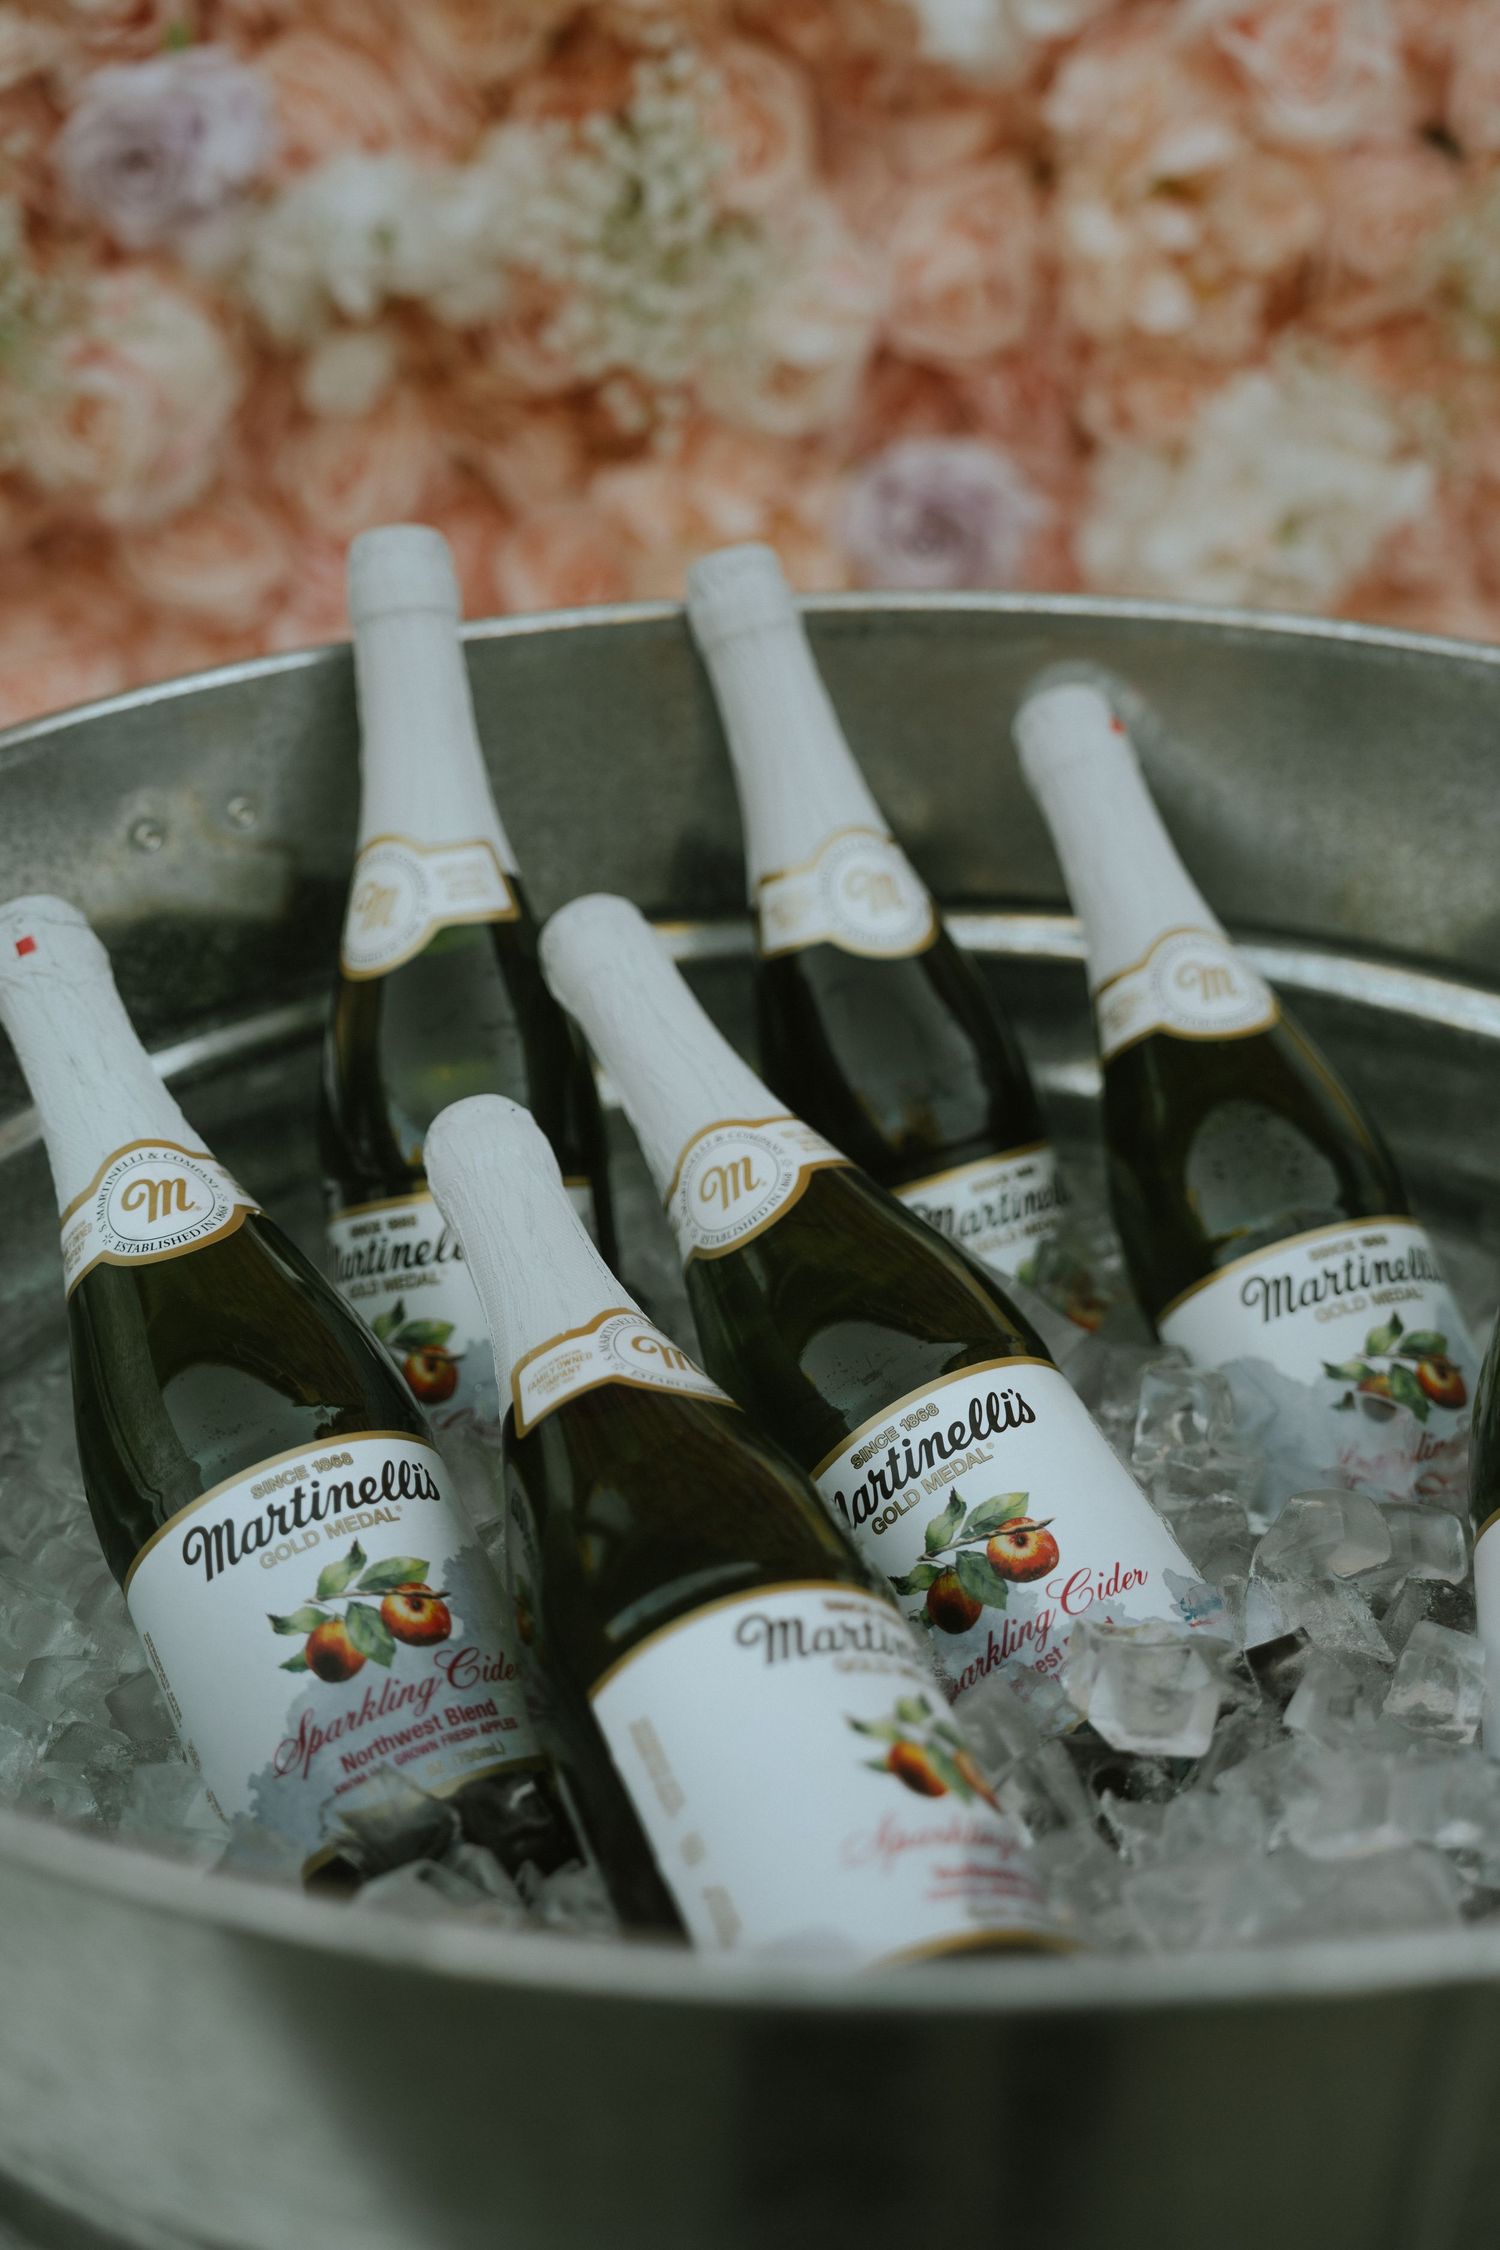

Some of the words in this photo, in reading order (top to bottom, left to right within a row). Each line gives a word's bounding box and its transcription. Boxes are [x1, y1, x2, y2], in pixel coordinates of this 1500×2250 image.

[97, 1152, 144, 1220] MARTINELLI
[147, 1151, 160, 1160] &
[163, 1151, 219, 1190] COMPANY
[121, 1178, 196, 1224] M
[700, 1156, 760, 1211] M
[114, 1229, 201, 1254] ESTABLISHED
[201, 1219, 216, 1233] IN
[213, 1204, 228, 1223] 1868
[850, 1426, 900, 1470] SINCE
[900, 1402, 940, 1431] 1868
[251, 1464, 309, 1500] SINCE
[311, 1451, 354, 1474] 1868
[182, 1460, 441, 1583] Martinelli's
[871, 1488, 922, 1536] GOLD
[259, 1530, 321, 1570] GOLD
[1045, 1561, 1149, 1616] Cider
[272, 1676, 443, 1780] Sparkling
[340, 1714, 443, 1775] Northwest
[444, 1698, 499, 1727] Blend
[393, 1741, 440, 1766] GROWN
[441, 1726, 479, 1747] FRESH
